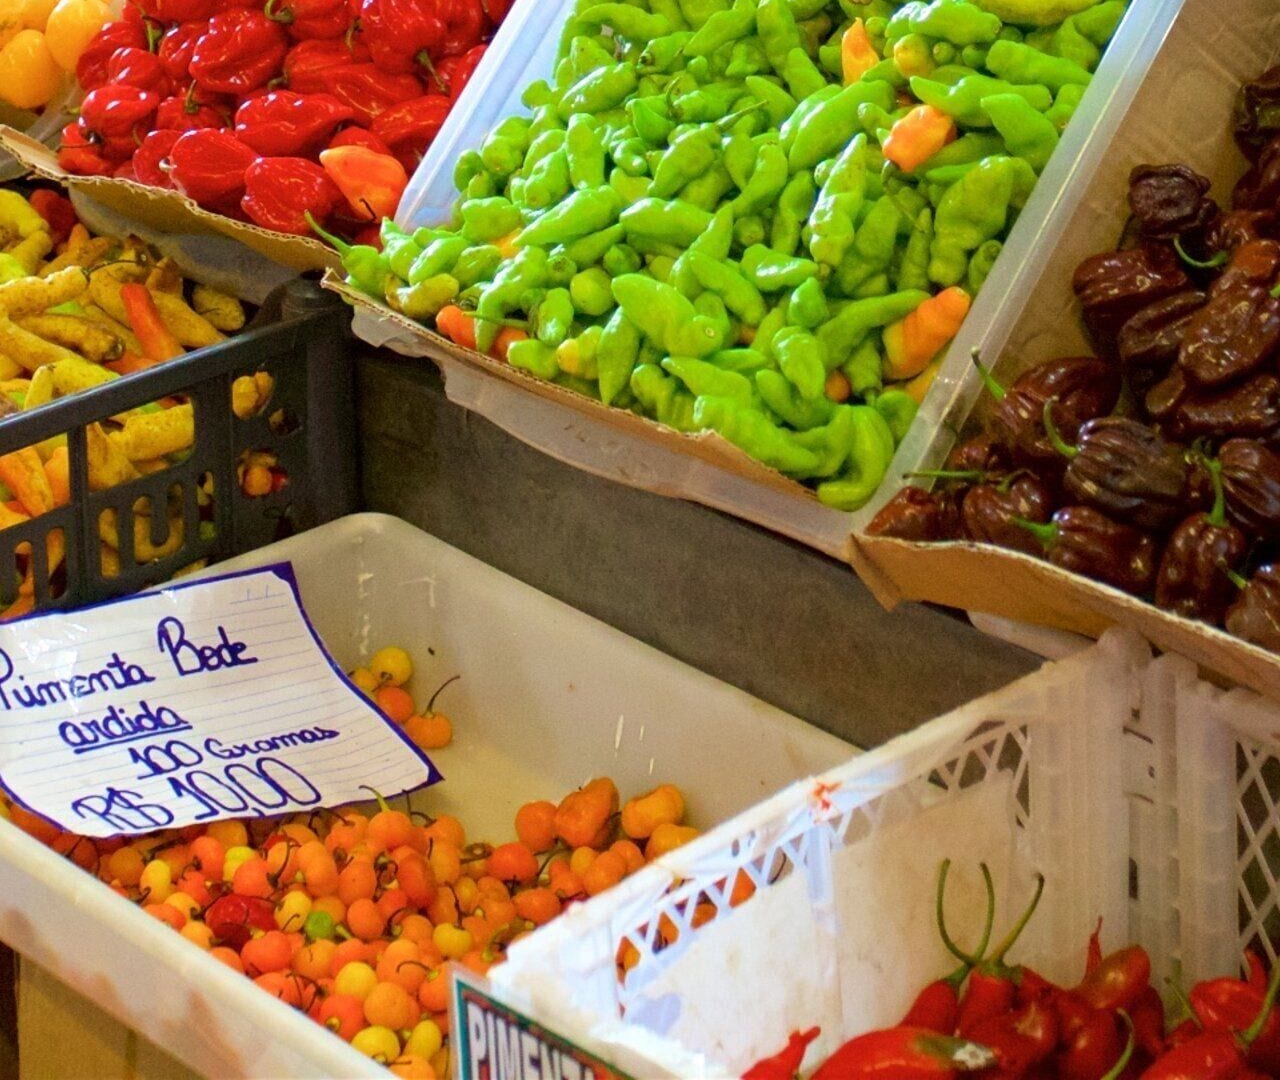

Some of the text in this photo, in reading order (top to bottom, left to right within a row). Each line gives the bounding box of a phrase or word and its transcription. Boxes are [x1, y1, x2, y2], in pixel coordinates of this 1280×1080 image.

[157, 615, 258, 677] Bode
[58, 702, 189, 747] ardida
[130, 725, 340, 780] 100 Gramas
[71, 757, 322, 833] R$ 10,00
[467, 1001, 600, 1080] PIMEN
